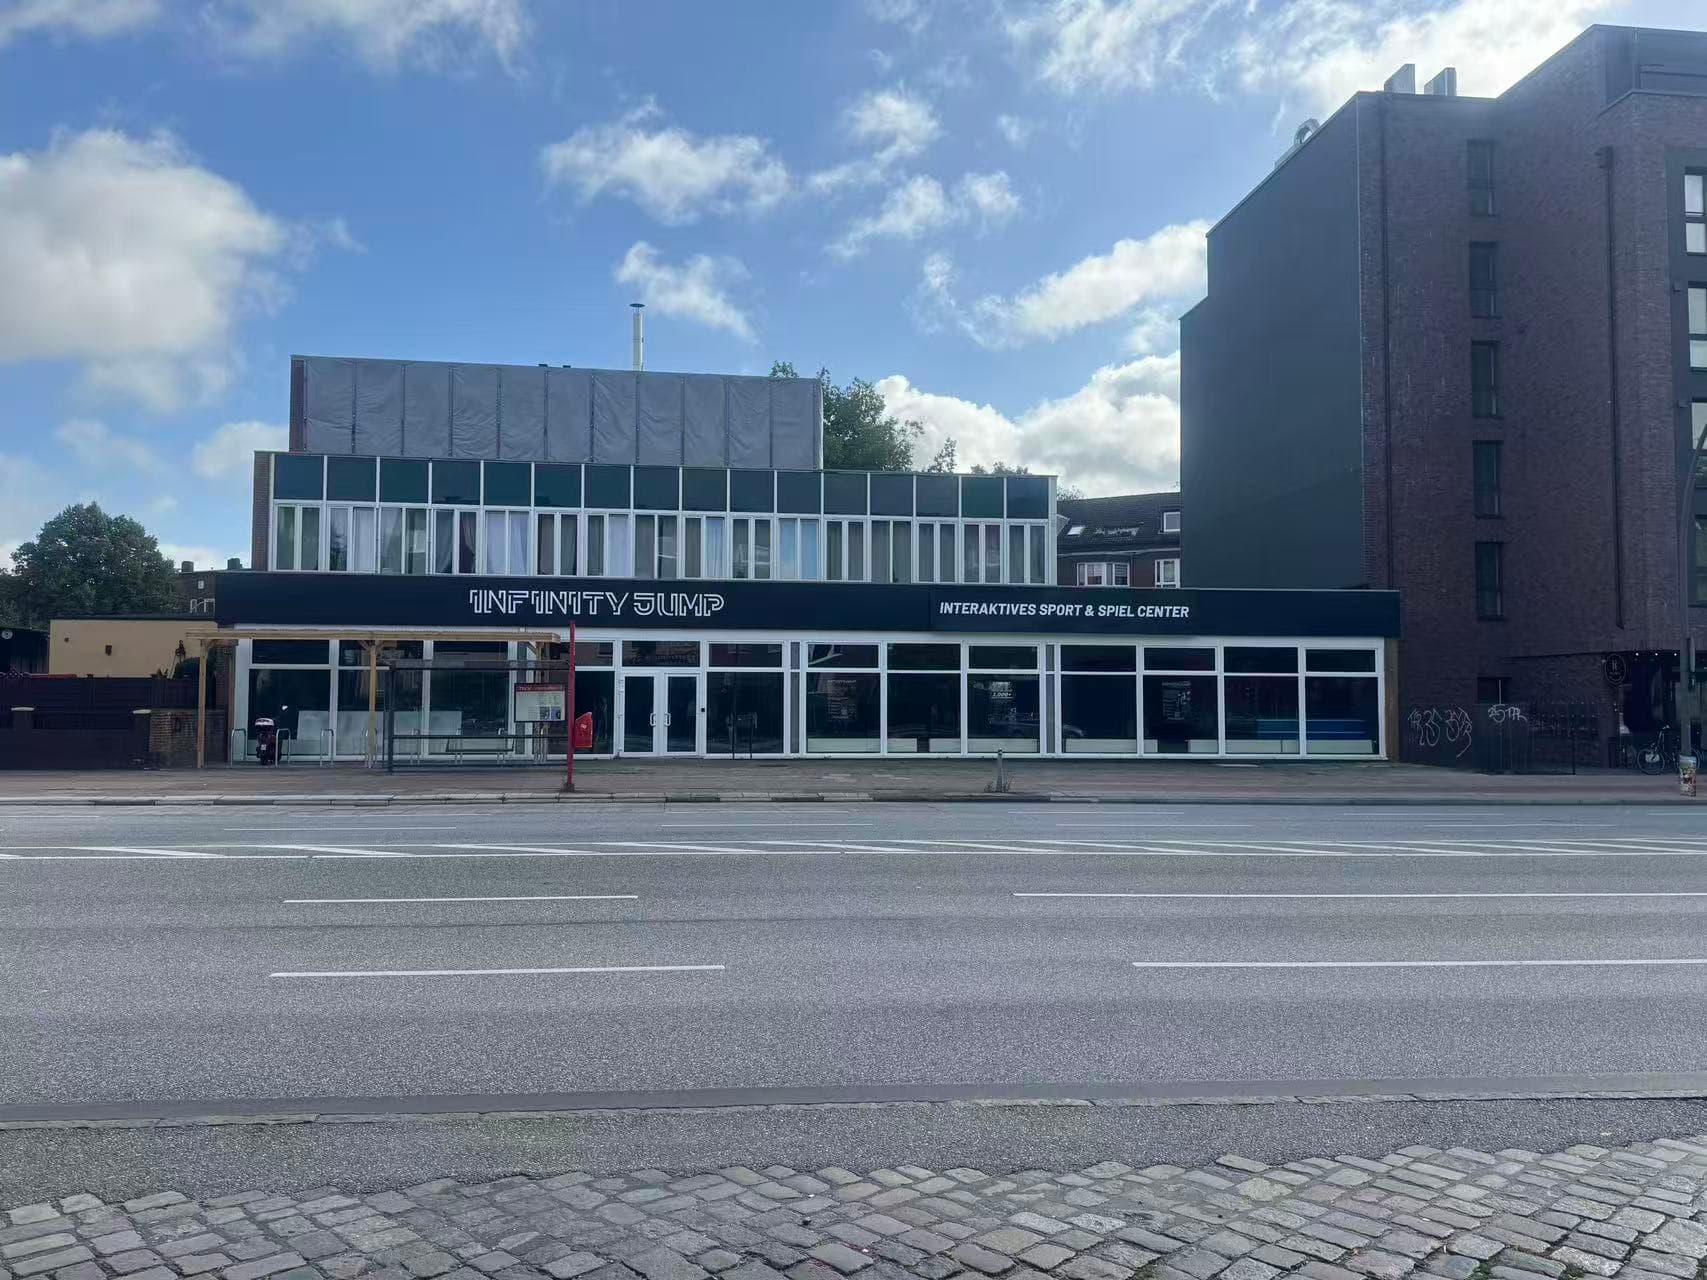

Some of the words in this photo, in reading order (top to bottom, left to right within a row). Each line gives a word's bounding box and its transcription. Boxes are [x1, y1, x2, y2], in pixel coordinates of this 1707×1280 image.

[469, 589, 629, 616] INFINITY
[633, 592, 725, 617] JUMP
[939, 601, 1037, 616] INTERAKTIVES
[1039, 603, 1083, 617] SPORT
[1084, 604, 1095, 617] &
[1098, 604, 1135, 618] SPIEL
[1137, 605, 1190, 619] CENTER
